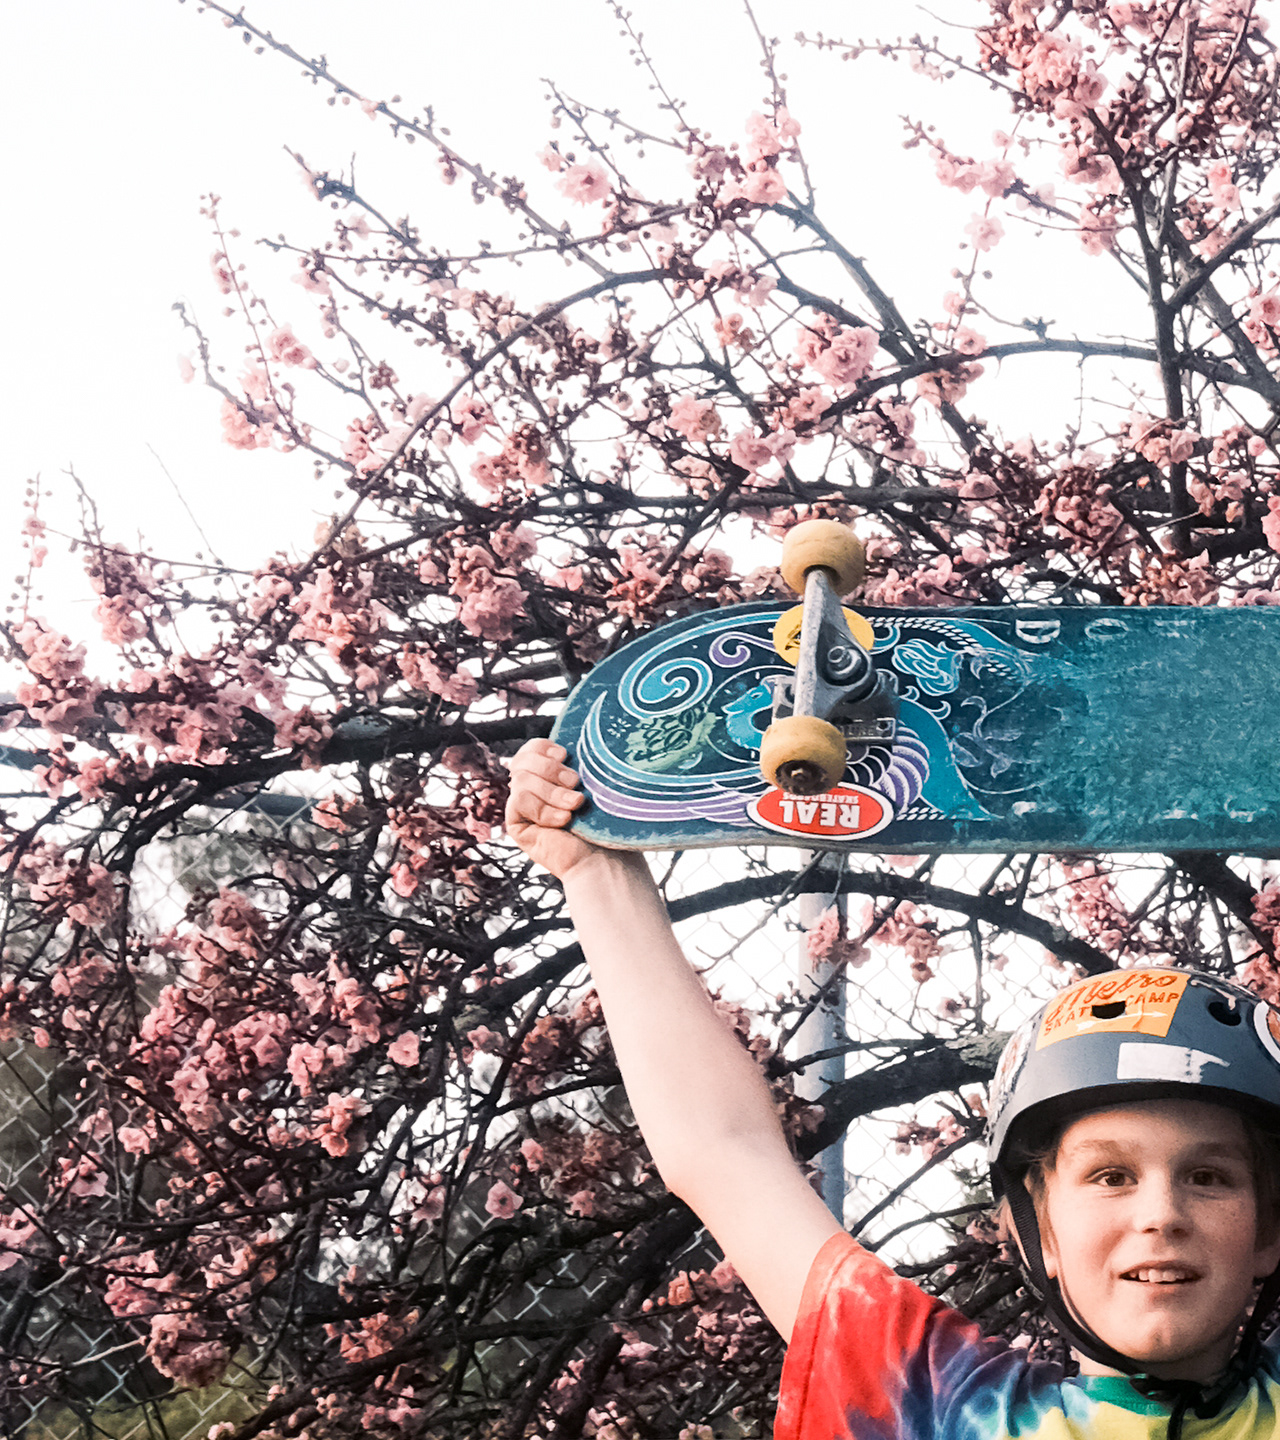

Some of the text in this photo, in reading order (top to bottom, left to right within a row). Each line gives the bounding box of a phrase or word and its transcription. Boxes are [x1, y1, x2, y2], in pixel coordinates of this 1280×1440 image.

[779, 800, 860, 829] REAL
[1044, 991, 1180, 1037] SKAT CAMP
[1045, 973, 1178, 1024] Metro
